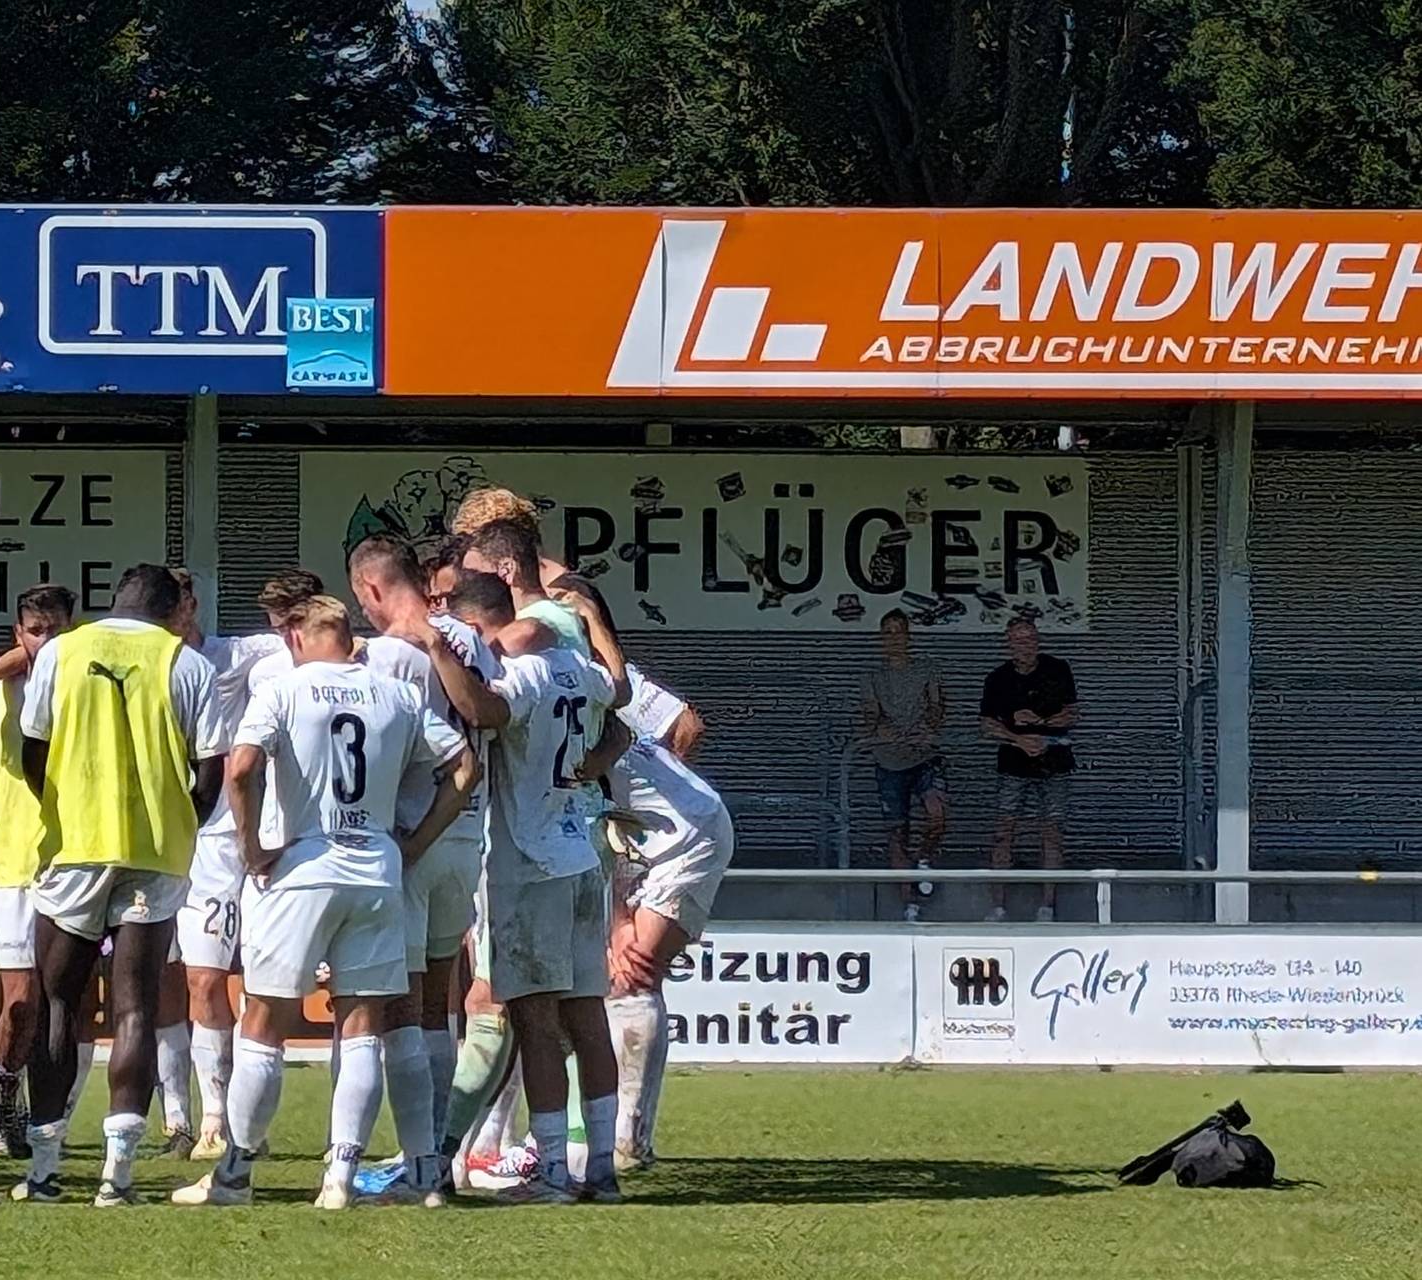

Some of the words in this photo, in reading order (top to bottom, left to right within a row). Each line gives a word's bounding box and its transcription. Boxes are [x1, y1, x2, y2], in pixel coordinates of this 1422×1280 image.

[76, 264, 288, 337] TTM
[292, 304, 369, 333] BEST
[859, 335, 1422, 364] ABBRUCHUNTERNEH
[563, 482, 1060, 594] PFLÜGER
[330, 712, 366, 804] 3
[204, 896, 238, 941] 28
[667, 941, 871, 993] eizung
[1030, 947, 1149, 1040] Gallery
[667, 1002, 852, 1046] anitär
